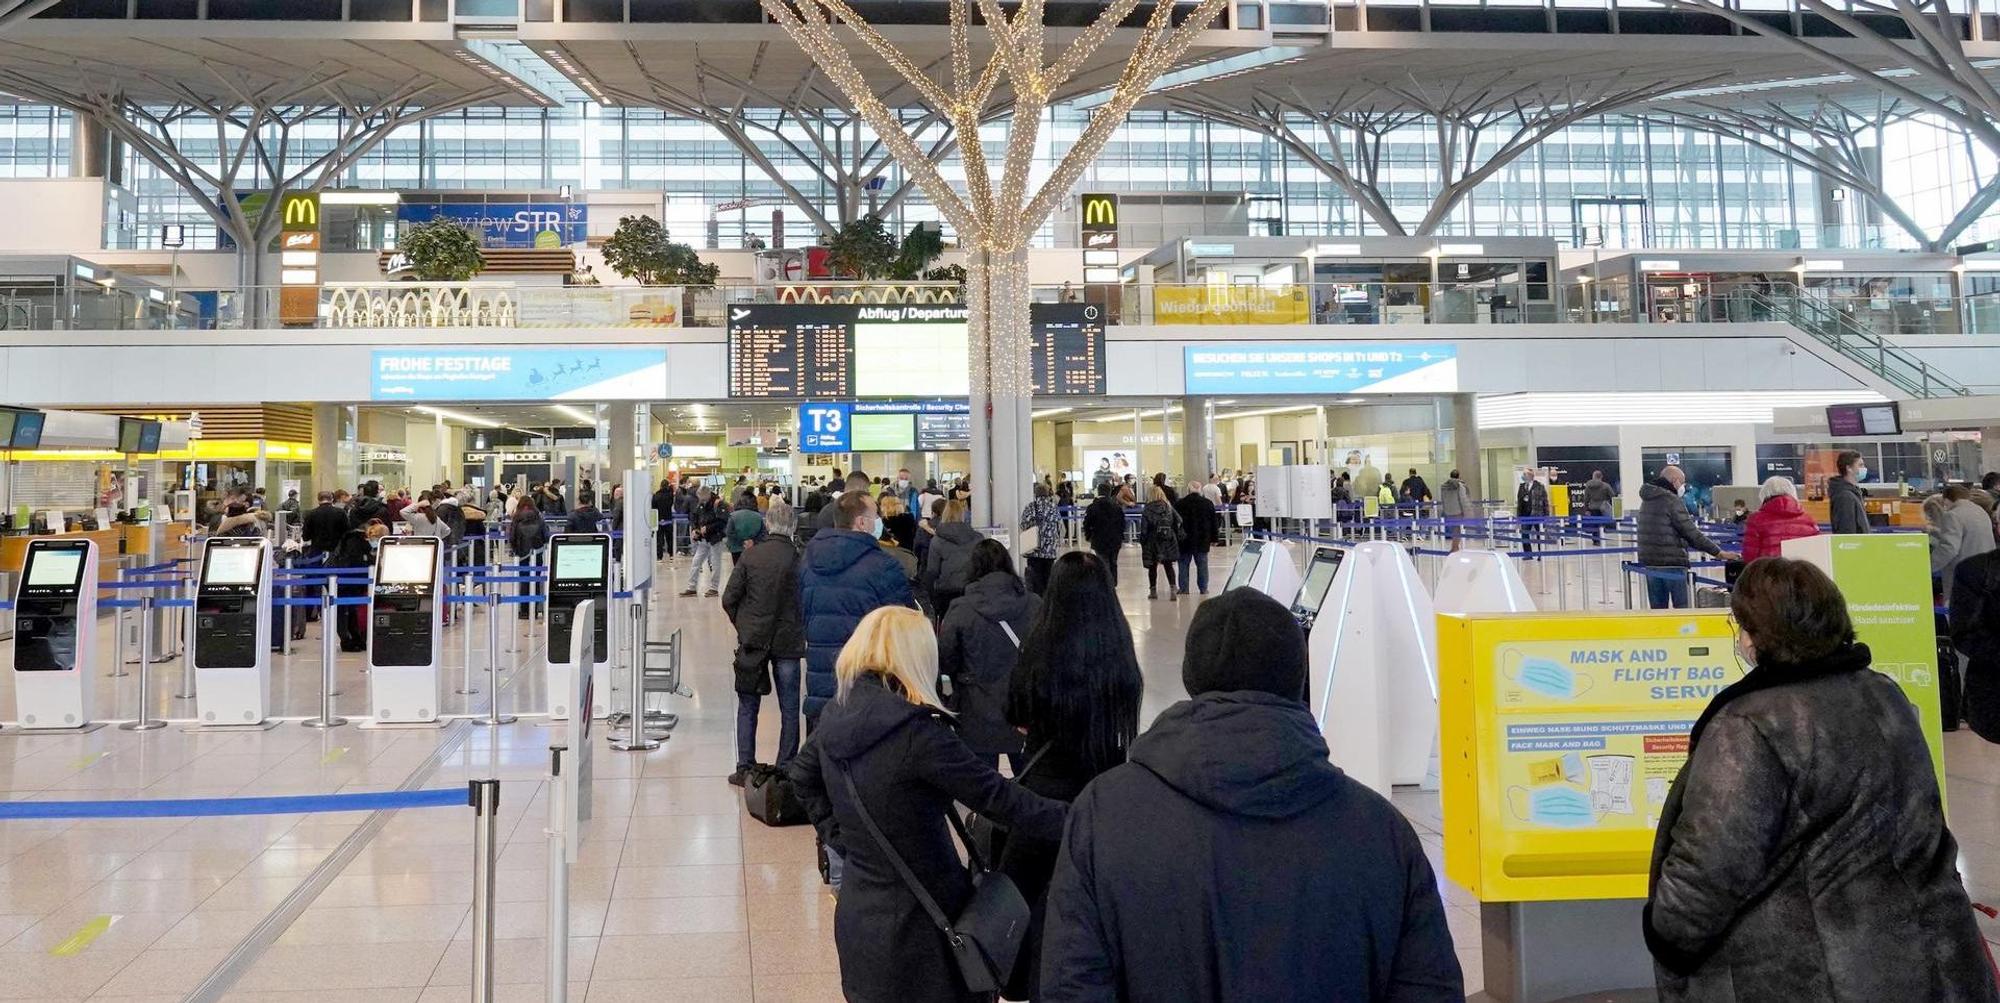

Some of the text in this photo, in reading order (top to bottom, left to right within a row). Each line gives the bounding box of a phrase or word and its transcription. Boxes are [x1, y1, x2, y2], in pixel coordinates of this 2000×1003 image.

[455, 211, 561, 233] viewSTR
[858, 307, 900, 321] Abflug
[901, 307, 907, 319] /
[380, 357, 511, 371] FROHE FESTTAGE
[1193, 352, 1247, 363] BESUCHEN
[1307, 352, 1341, 362] SHOPS
[855, 403, 921, 411] Sicherheitskontrolle
[926, 404, 953, 412] Security
[807, 409, 842, 432] T3
[514, 453, 547, 461] CODE
[1855, 616, 1877, 624] Hand
[1570, 649, 1668, 664] MASK AND
[1613, 666, 1725, 682] FLIGHT BAG
[1651, 684, 1726, 699] SERVI
[1511, 726, 1545, 734] EINWEG
[1547, 725, 1599, 733] NASE-MUND
[1601, 723, 1665, 732] SCHUTZMASKE
[1511, 741, 1534, 749] FACE
[1583, 739, 1601, 747] BAG
